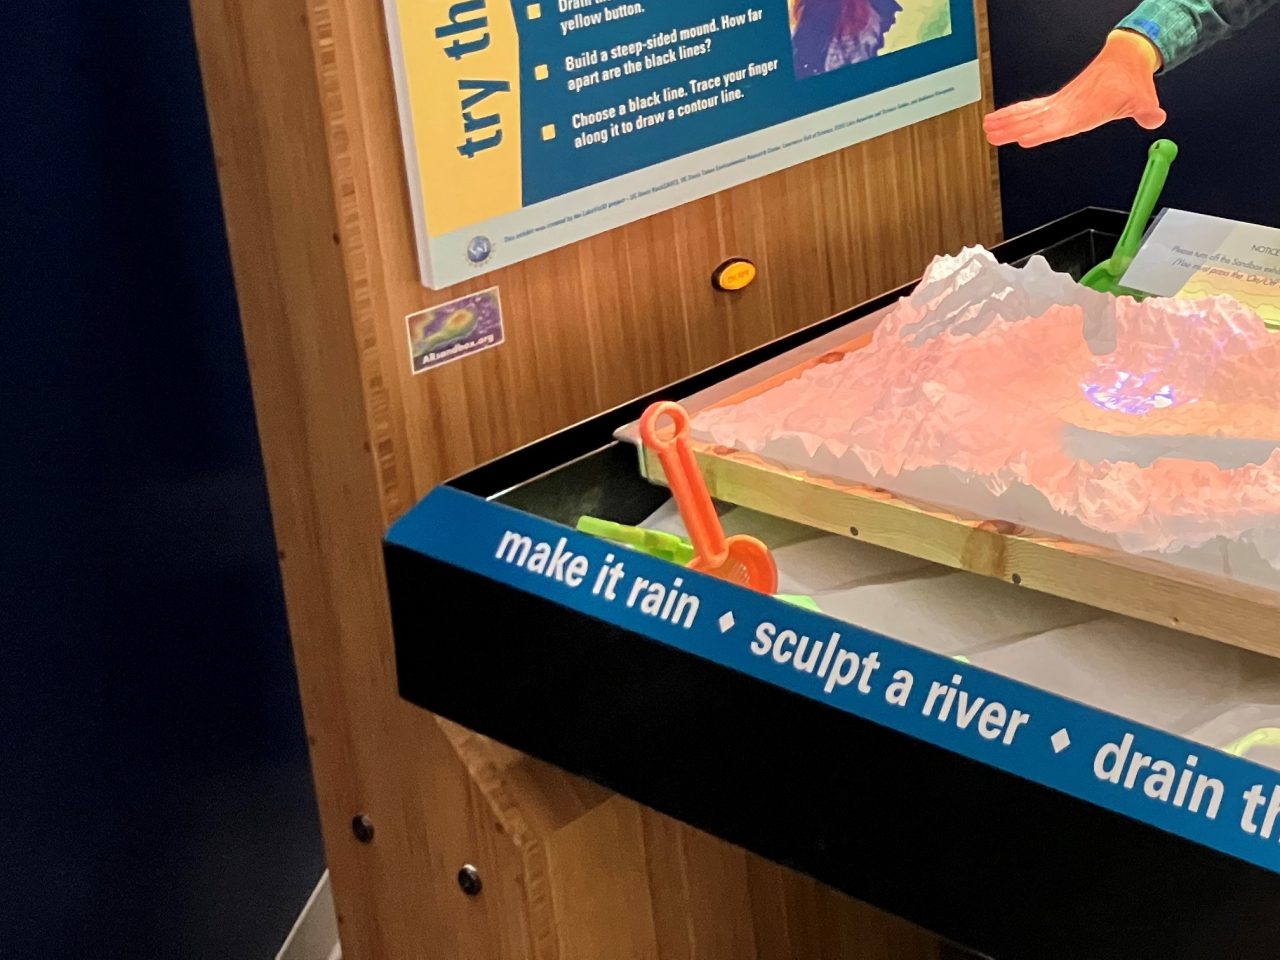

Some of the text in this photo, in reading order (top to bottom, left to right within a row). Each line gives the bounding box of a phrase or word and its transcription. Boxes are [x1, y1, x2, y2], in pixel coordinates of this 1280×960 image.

[560, 2, 645, 36] yellow button.
[457, 81, 511, 157] try
[572, 59, 778, 129] Choose a black line. Trace your finger
[1251, 244, 1280, 257] NOTICE
[496, 531, 588, 587] make
[593, 554, 622, 600] it
[627, 577, 699, 628] rain
[751, 622, 880, 694] sculpt
[885, 670, 913, 706] a
[922, 682, 1029, 745] river
[1094, 735, 1224, 819] drain
